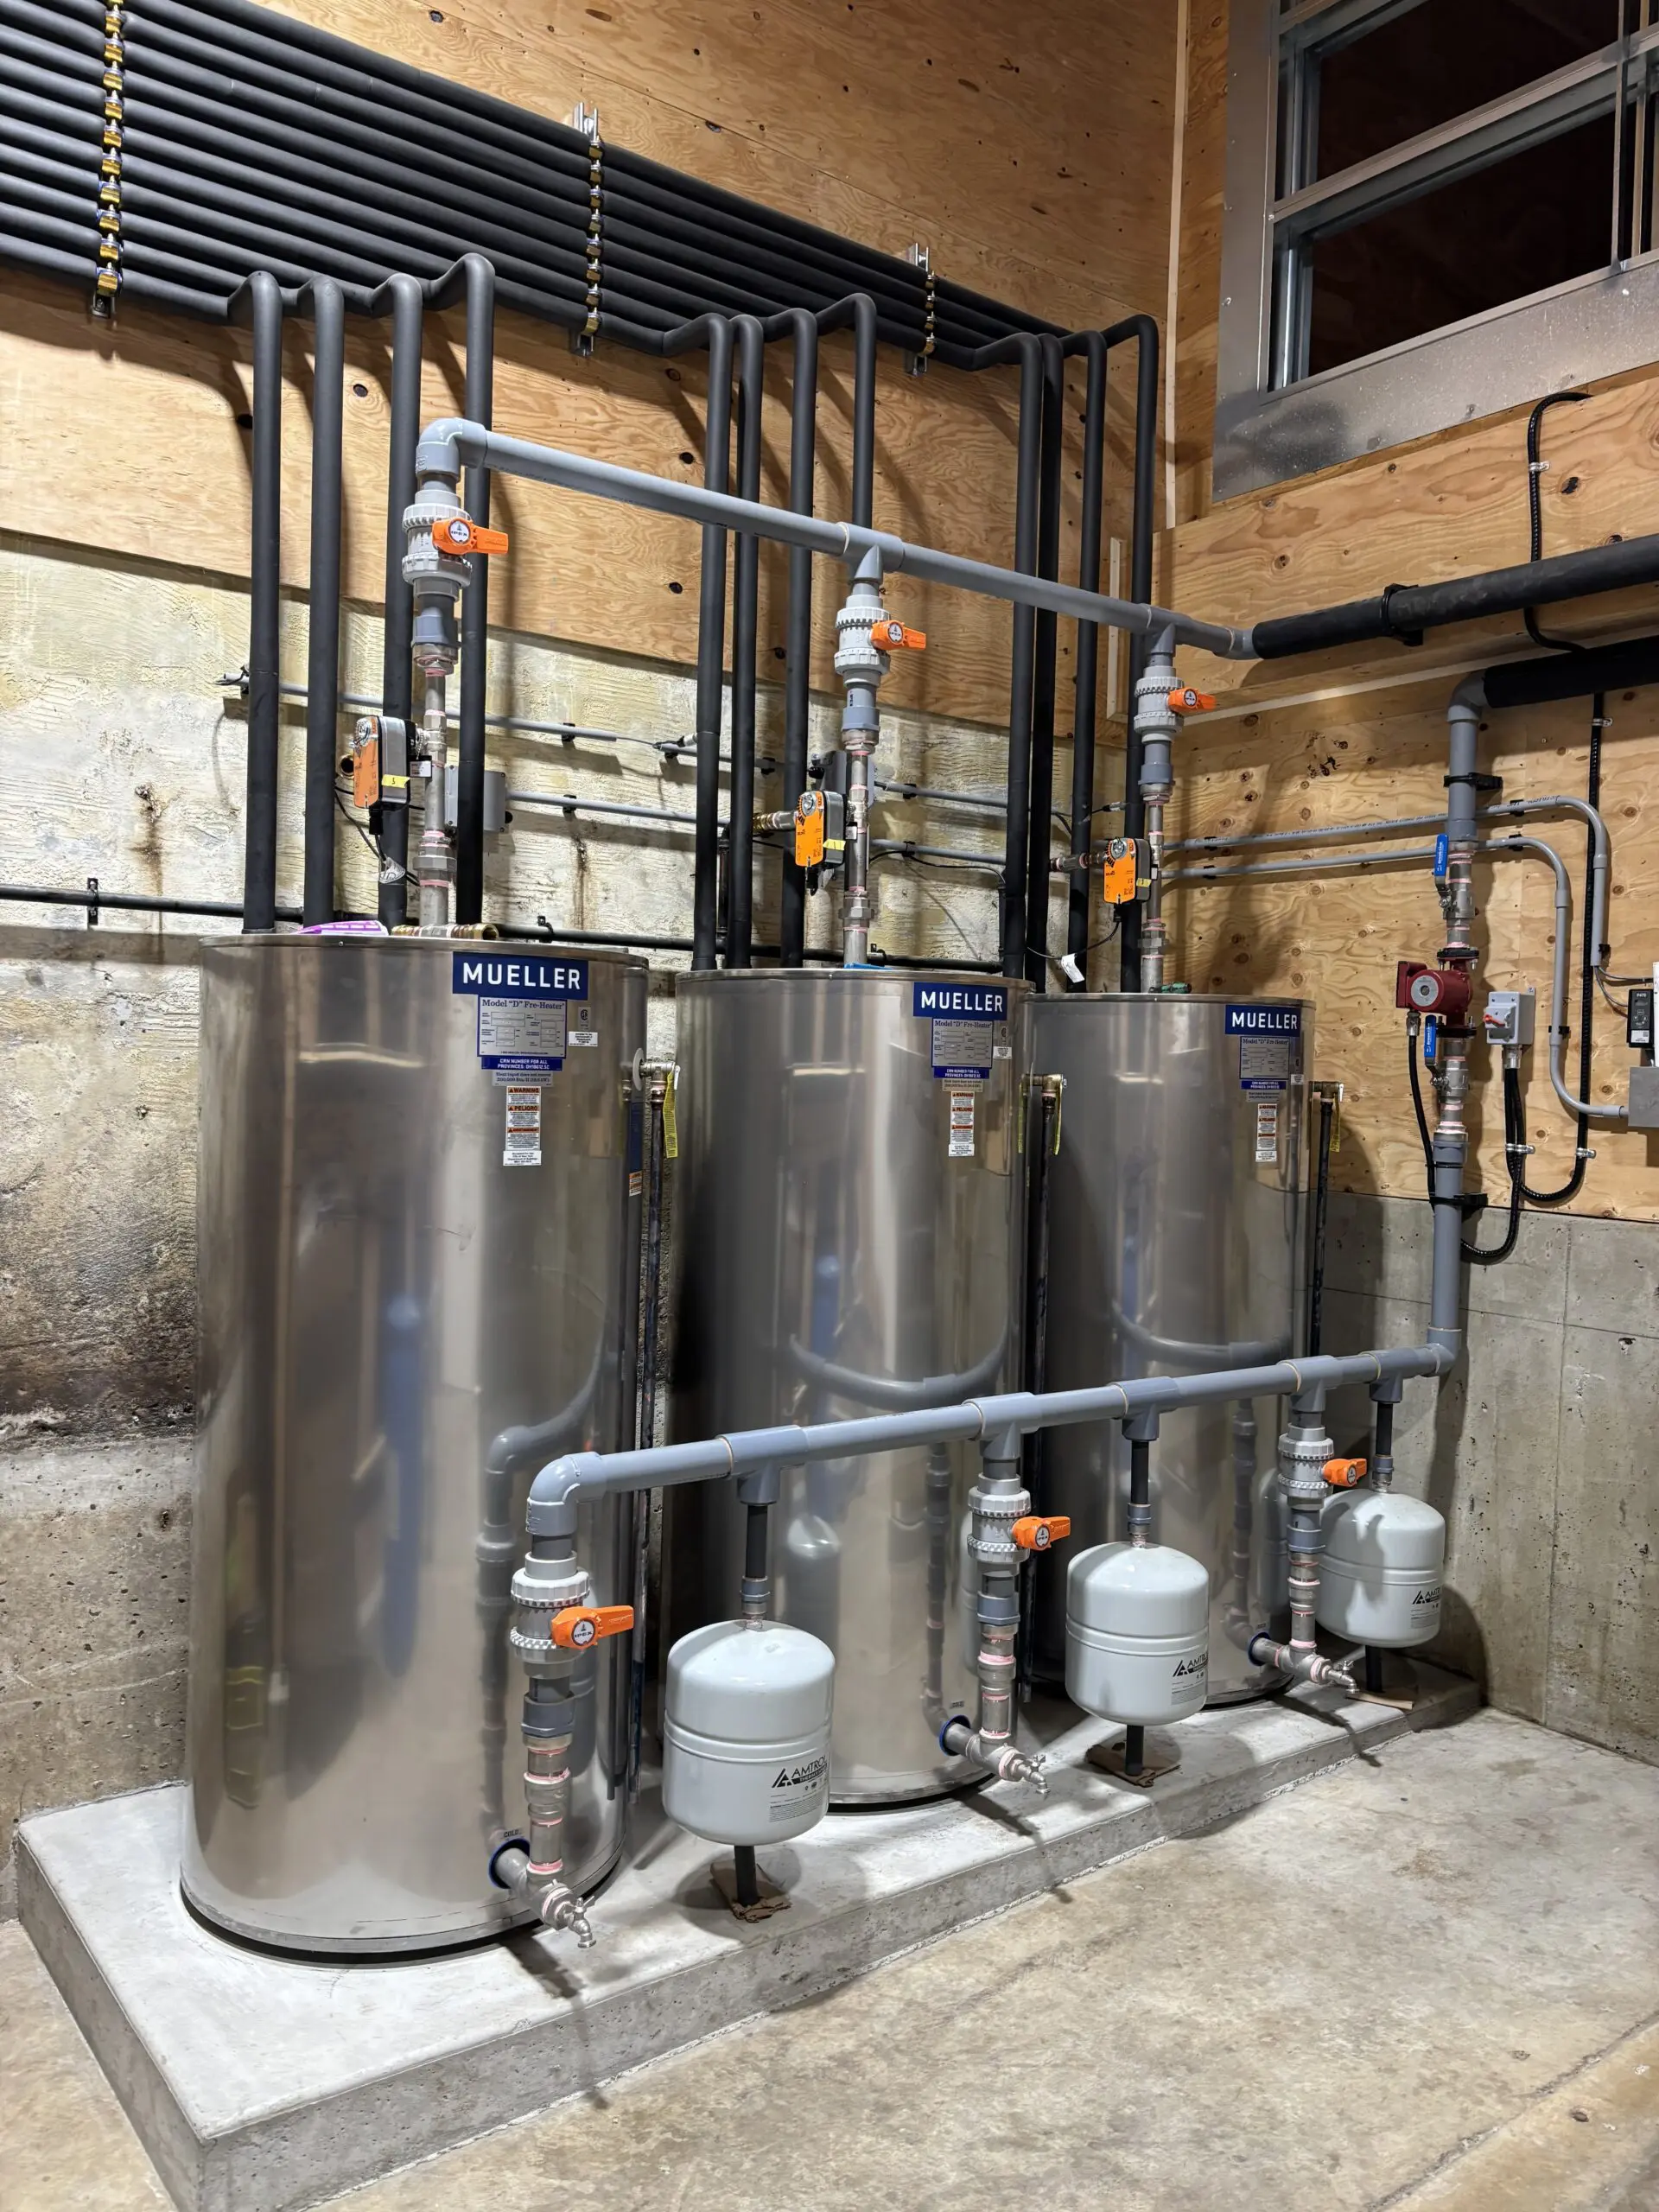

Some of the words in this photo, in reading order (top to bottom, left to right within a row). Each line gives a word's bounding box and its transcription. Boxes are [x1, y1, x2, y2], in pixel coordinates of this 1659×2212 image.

[462, 962, 581, 990] MUELLER
[482, 999, 507, 1007] Model
[921, 991, 1003, 1013] MUELLER
[1231, 1012, 1298, 1030] MUELLER
